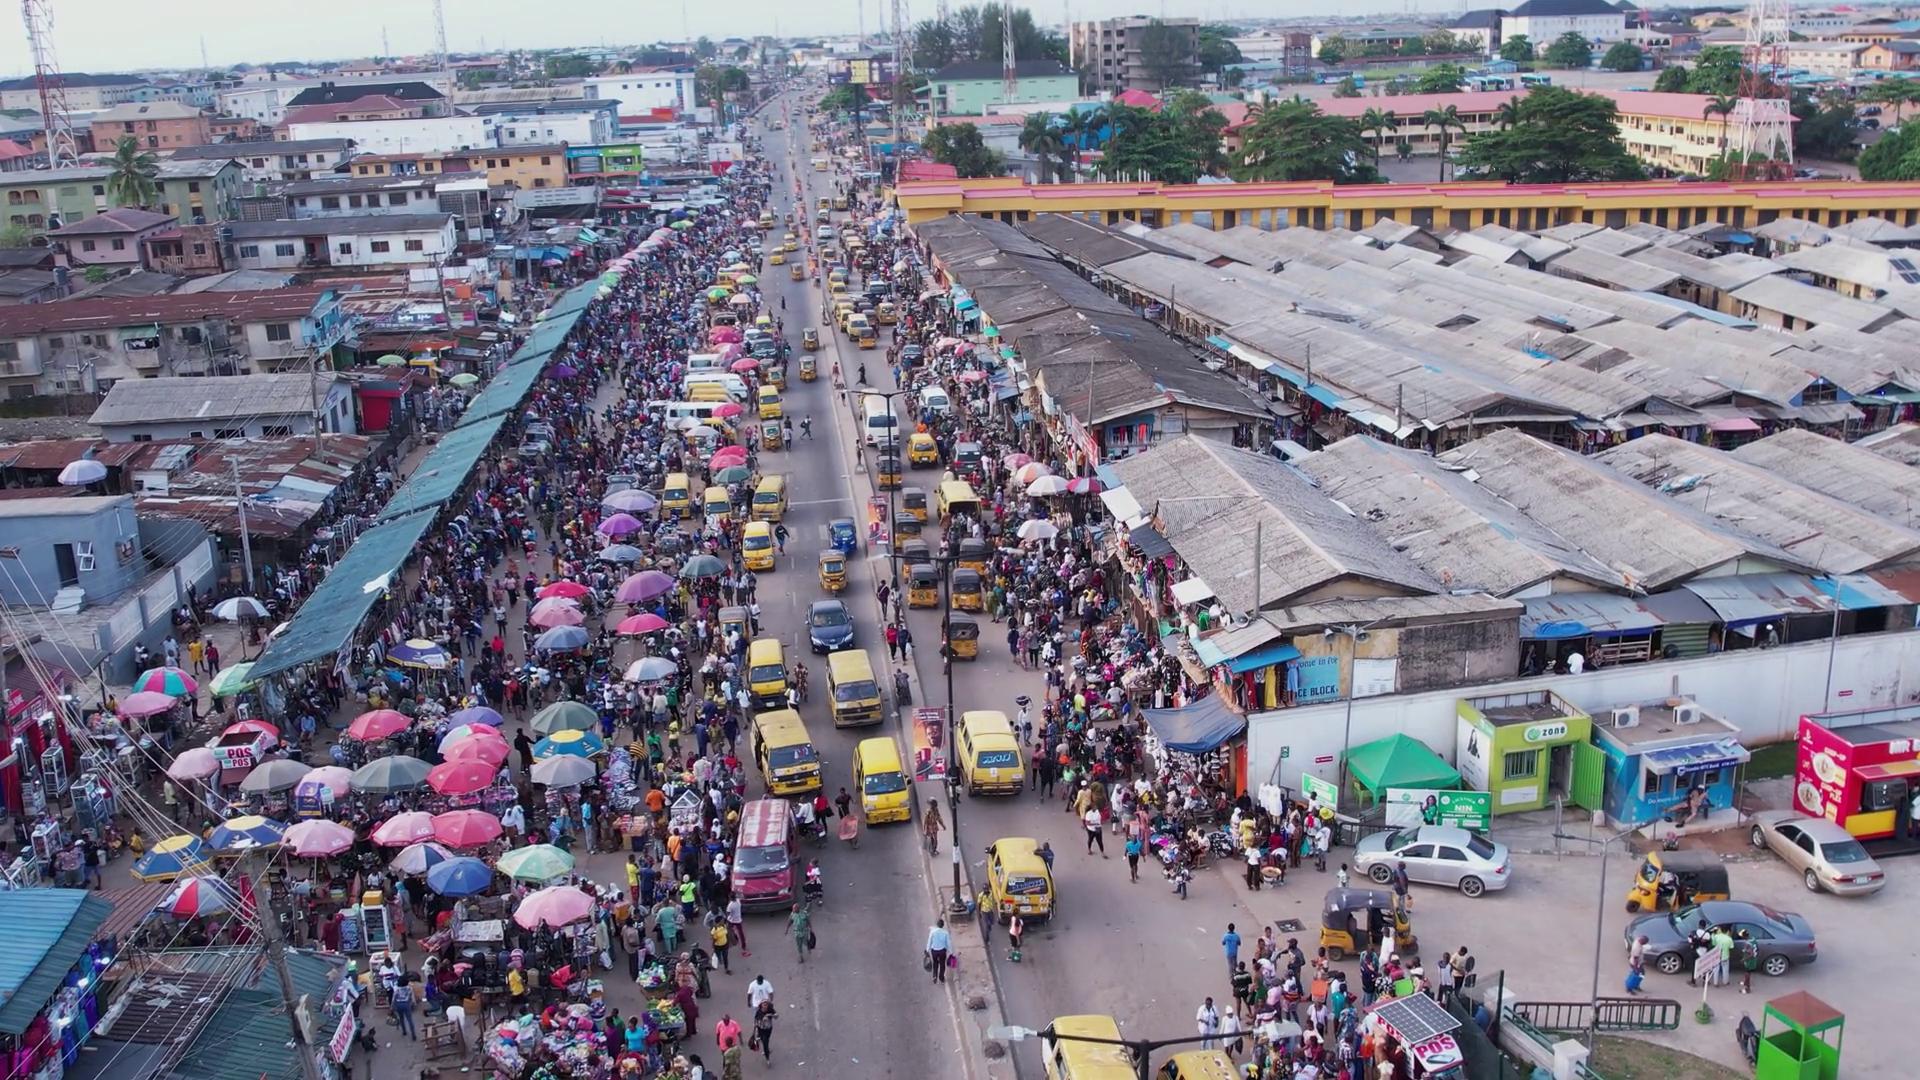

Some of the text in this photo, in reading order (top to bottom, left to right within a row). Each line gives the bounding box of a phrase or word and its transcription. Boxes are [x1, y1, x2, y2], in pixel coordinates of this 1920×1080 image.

[227, 747, 253, 759] POS
[232, 759, 249, 767] POS
[1415, 1036, 1455, 1058] POS
